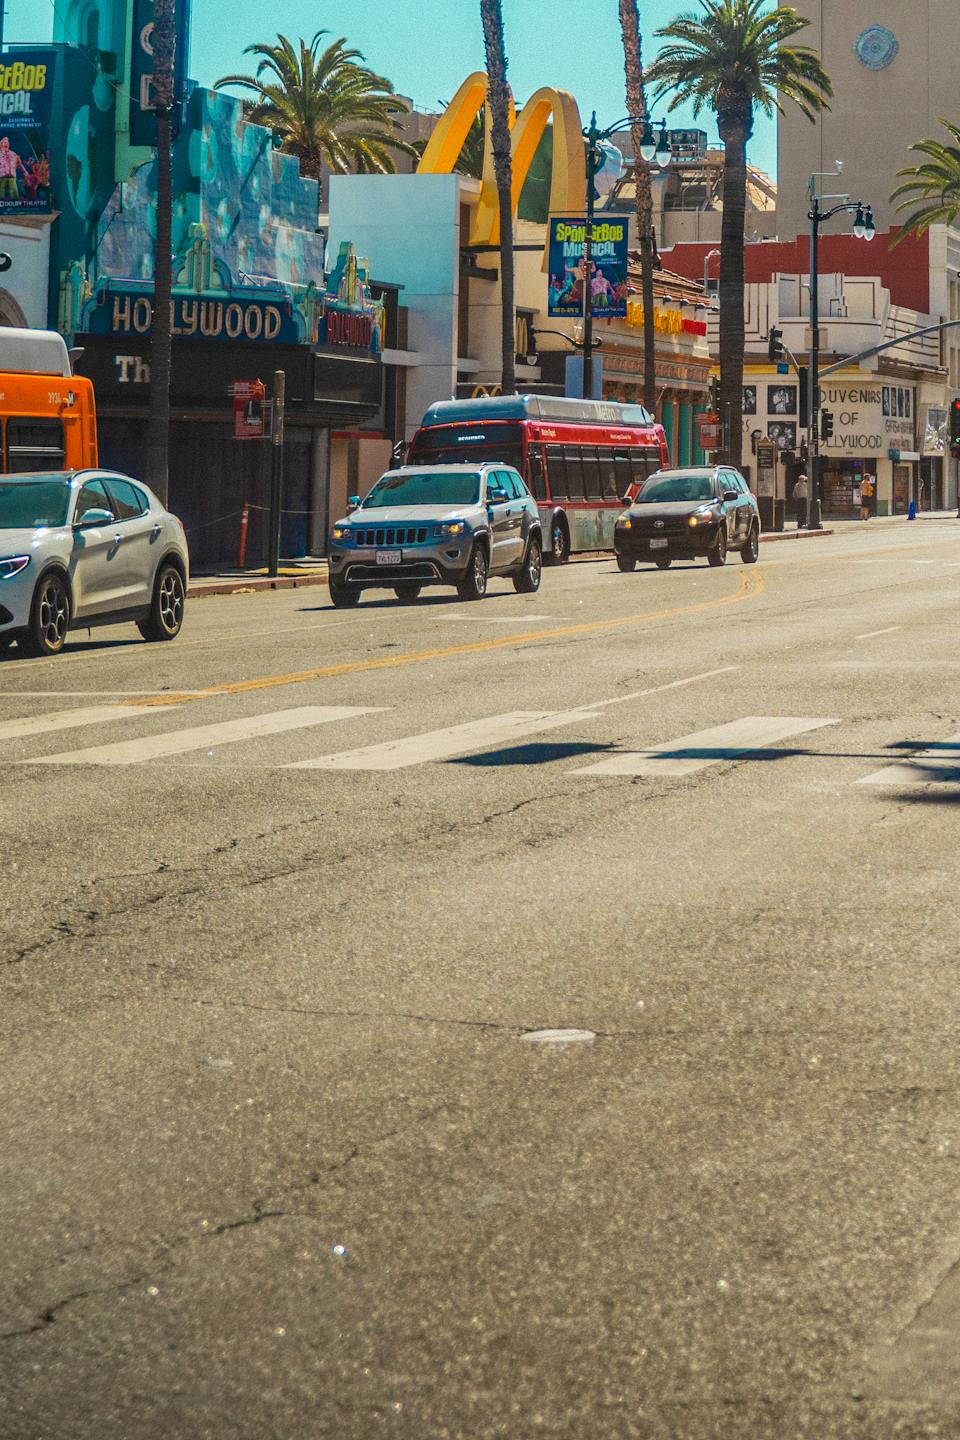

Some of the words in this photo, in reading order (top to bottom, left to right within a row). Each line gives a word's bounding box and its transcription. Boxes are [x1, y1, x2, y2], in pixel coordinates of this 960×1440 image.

[112, 296, 282, 339] HOLYWOOD
[820, 389, 881, 404] OUVENIRS
[840, 411, 860, 425] OF
